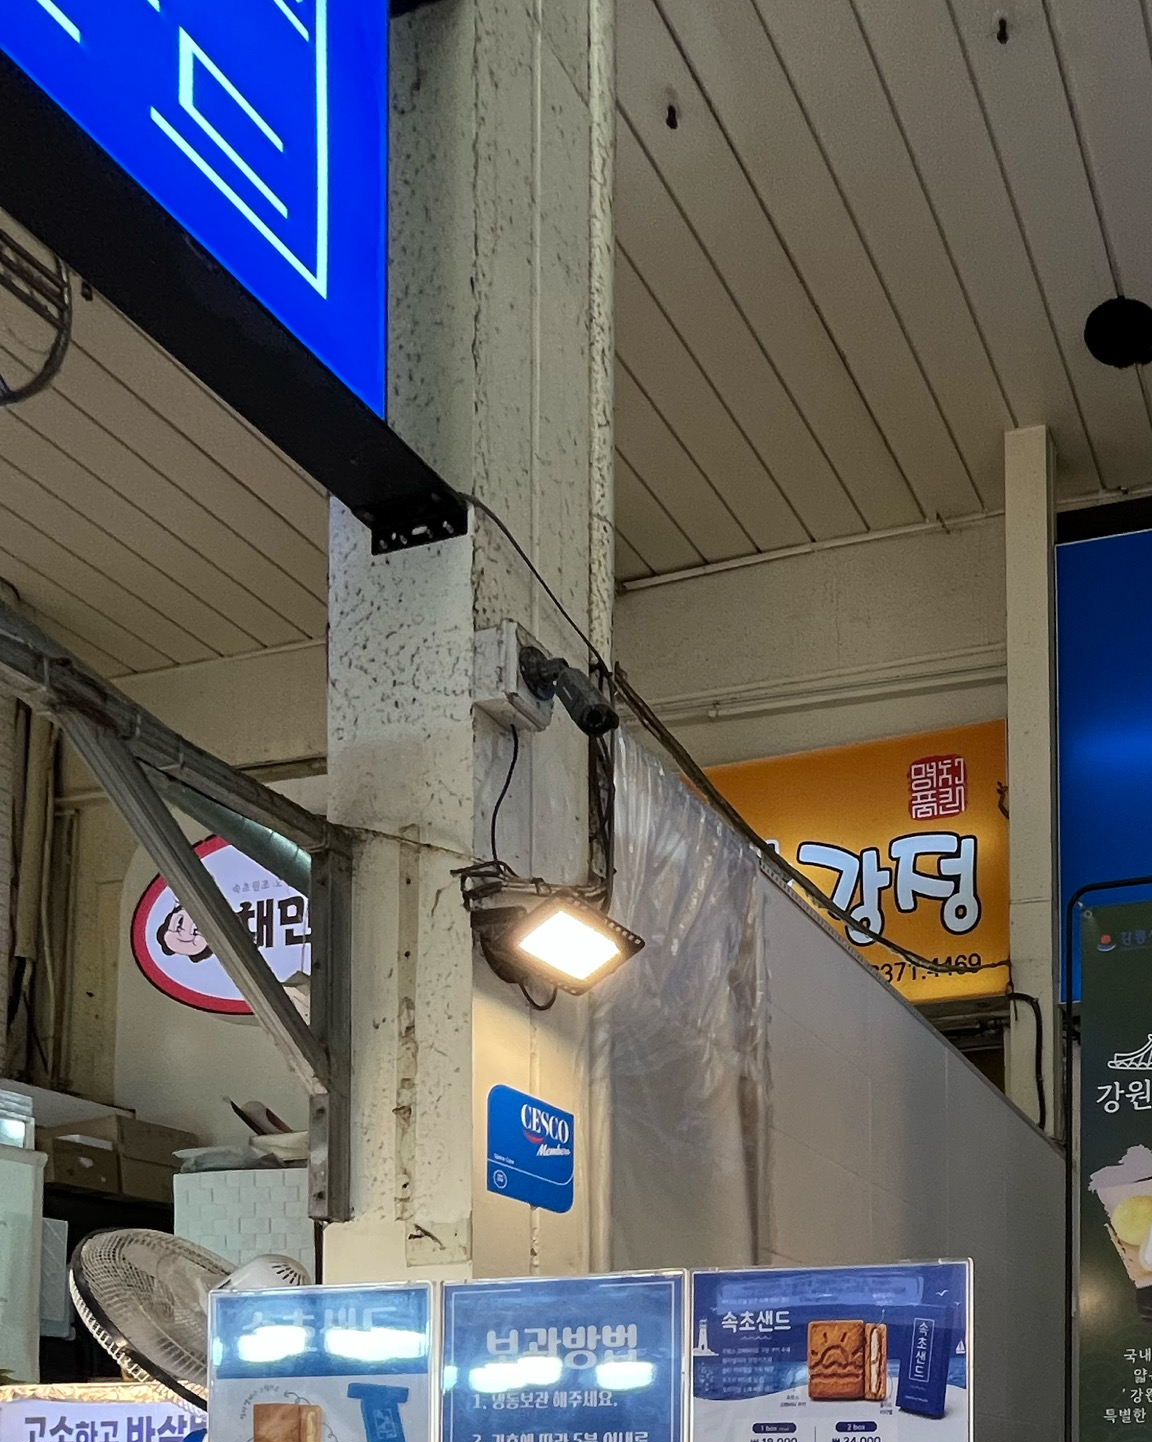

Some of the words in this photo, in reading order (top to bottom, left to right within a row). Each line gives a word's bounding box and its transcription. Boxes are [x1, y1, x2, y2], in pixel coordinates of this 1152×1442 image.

[764, 832, 981, 946] 강정
[521, 1104, 569, 1144] CESCO
[721, 1310, 792, 1334] 속초샌드
[914, 1321, 930, 1378] 속초샌드
[474, 1393, 487, 1410] 1.
[492, 1391, 549, 1410] 냉동보관
[553, 1391, 618, 1408] 해주세요.
[1103, 1407, 1147, 1424] 특별한
